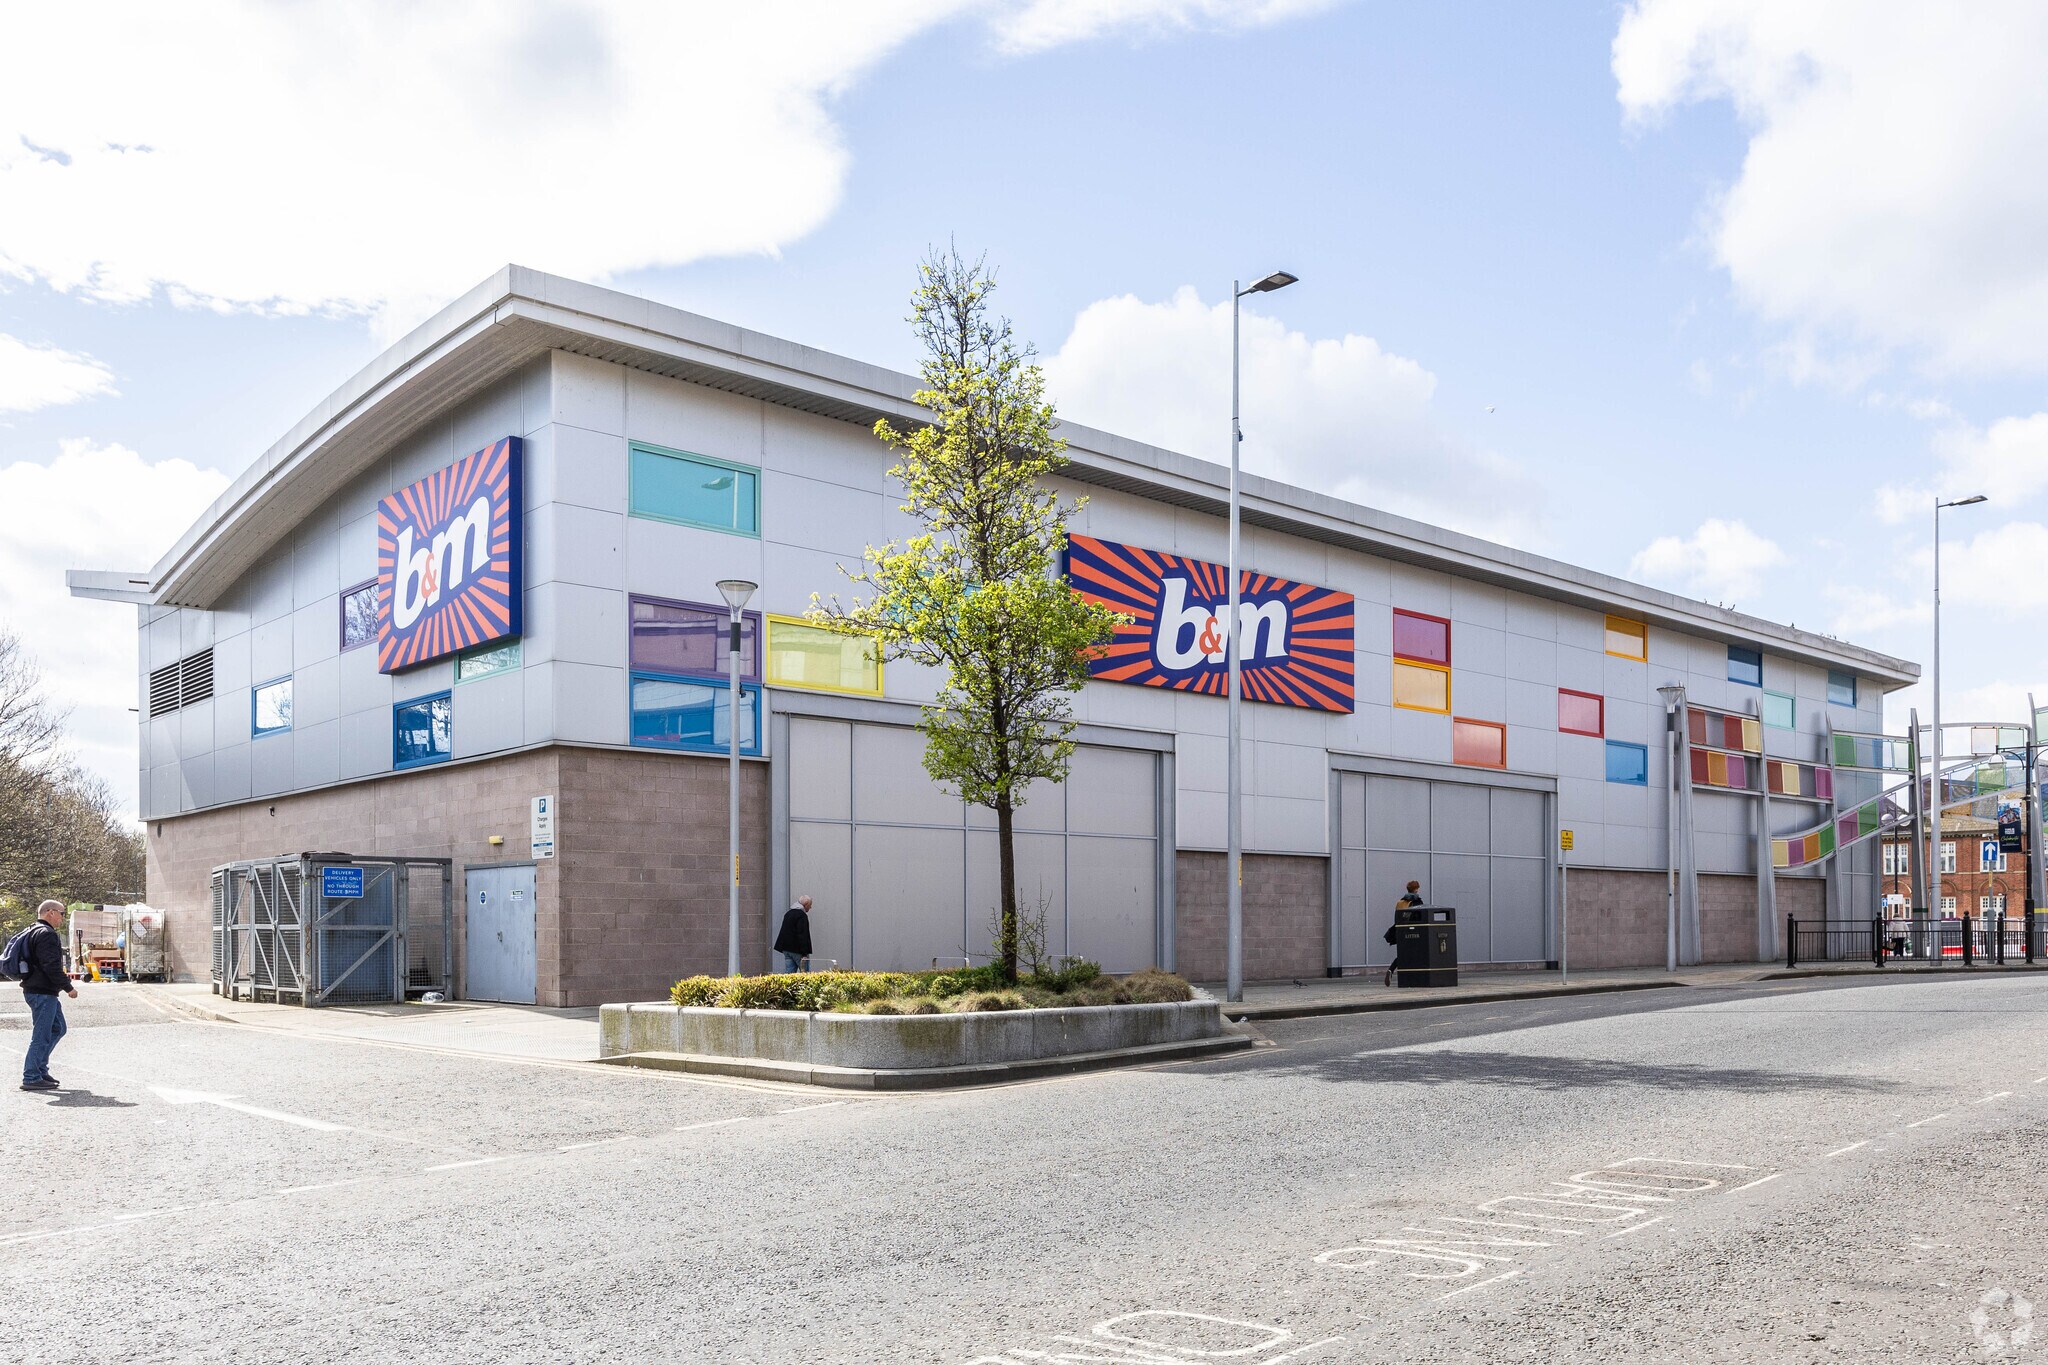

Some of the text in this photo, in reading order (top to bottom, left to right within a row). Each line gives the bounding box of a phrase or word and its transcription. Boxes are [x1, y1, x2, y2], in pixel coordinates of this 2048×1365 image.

[393, 496, 491, 630] b&m
[1156, 577, 1289, 670] b&m
[1313, 1157, 1757, 1279] LOADING
